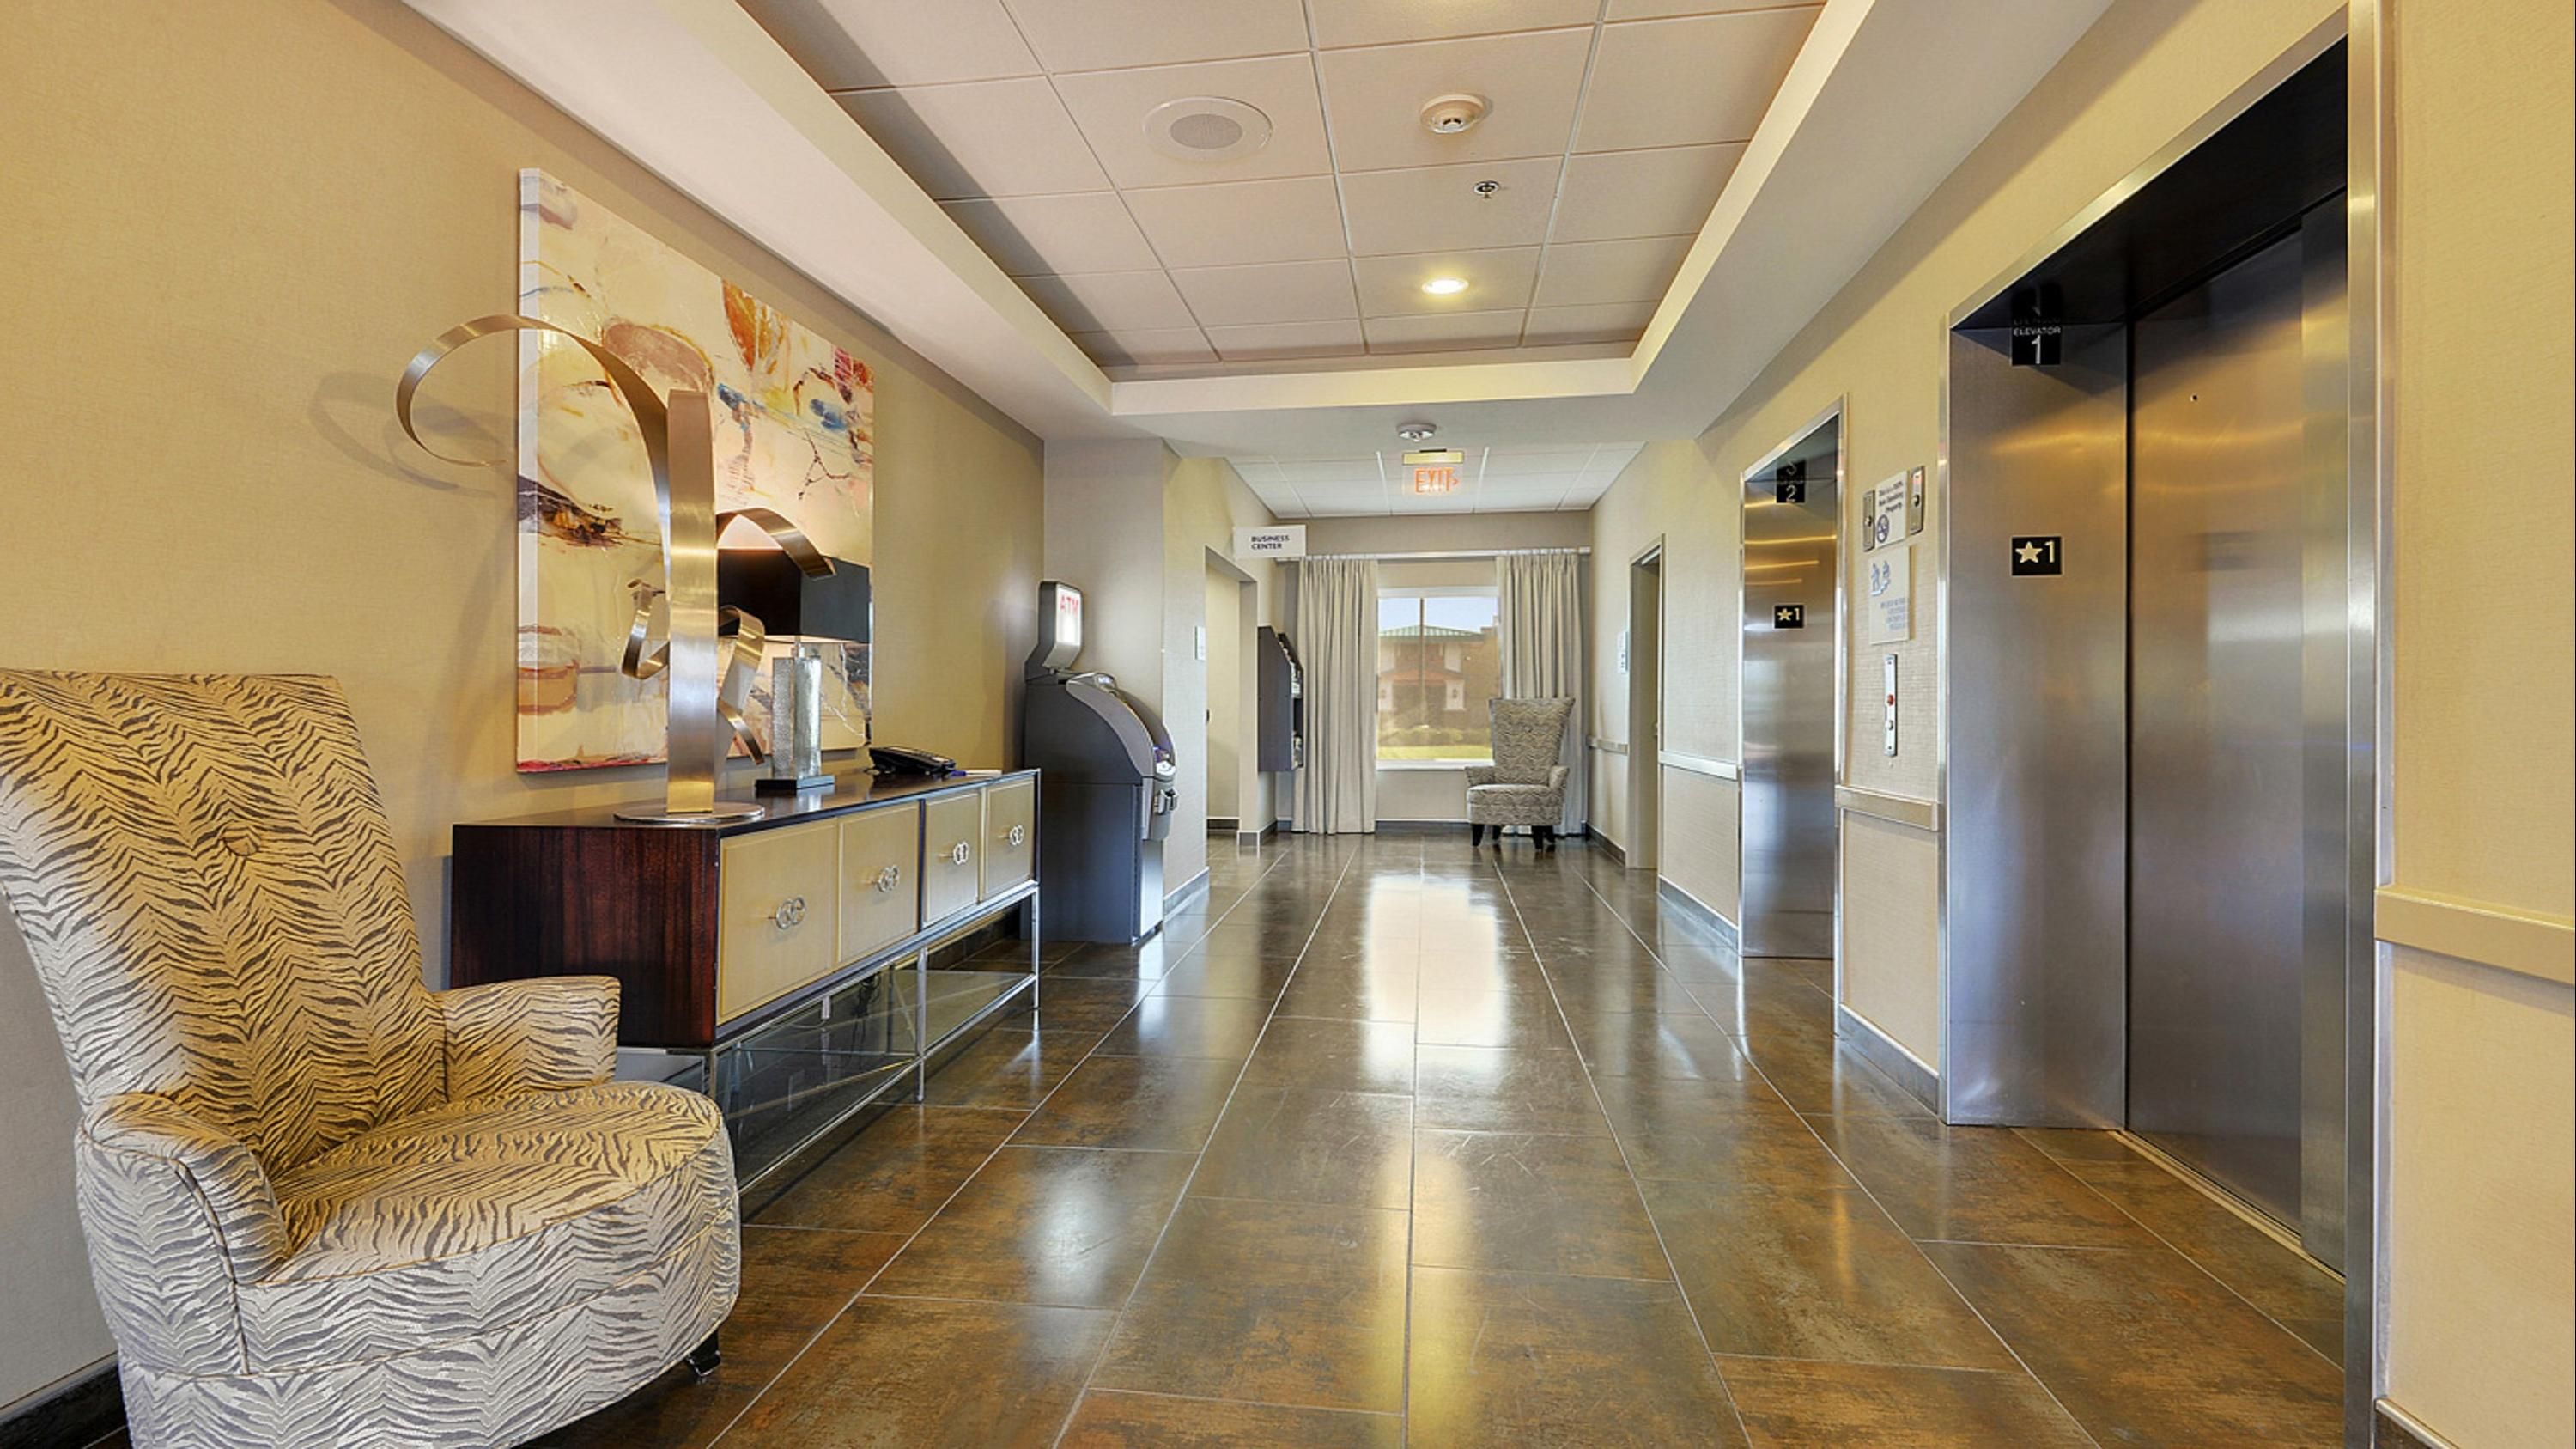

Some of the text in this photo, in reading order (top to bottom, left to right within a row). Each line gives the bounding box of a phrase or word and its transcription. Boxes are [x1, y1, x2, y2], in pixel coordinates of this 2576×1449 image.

[2013, 326, 2061, 336] ELEVATOR
[2031, 334, 2041, 364] 1
[1414, 466, 1454, 495] EXIT
[1786, 484, 1796, 502] 2
[2044, 539, 2056, 563] 1
[1060, 594, 1079, 617] ATM
[1794, 607, 1800, 621] 1
